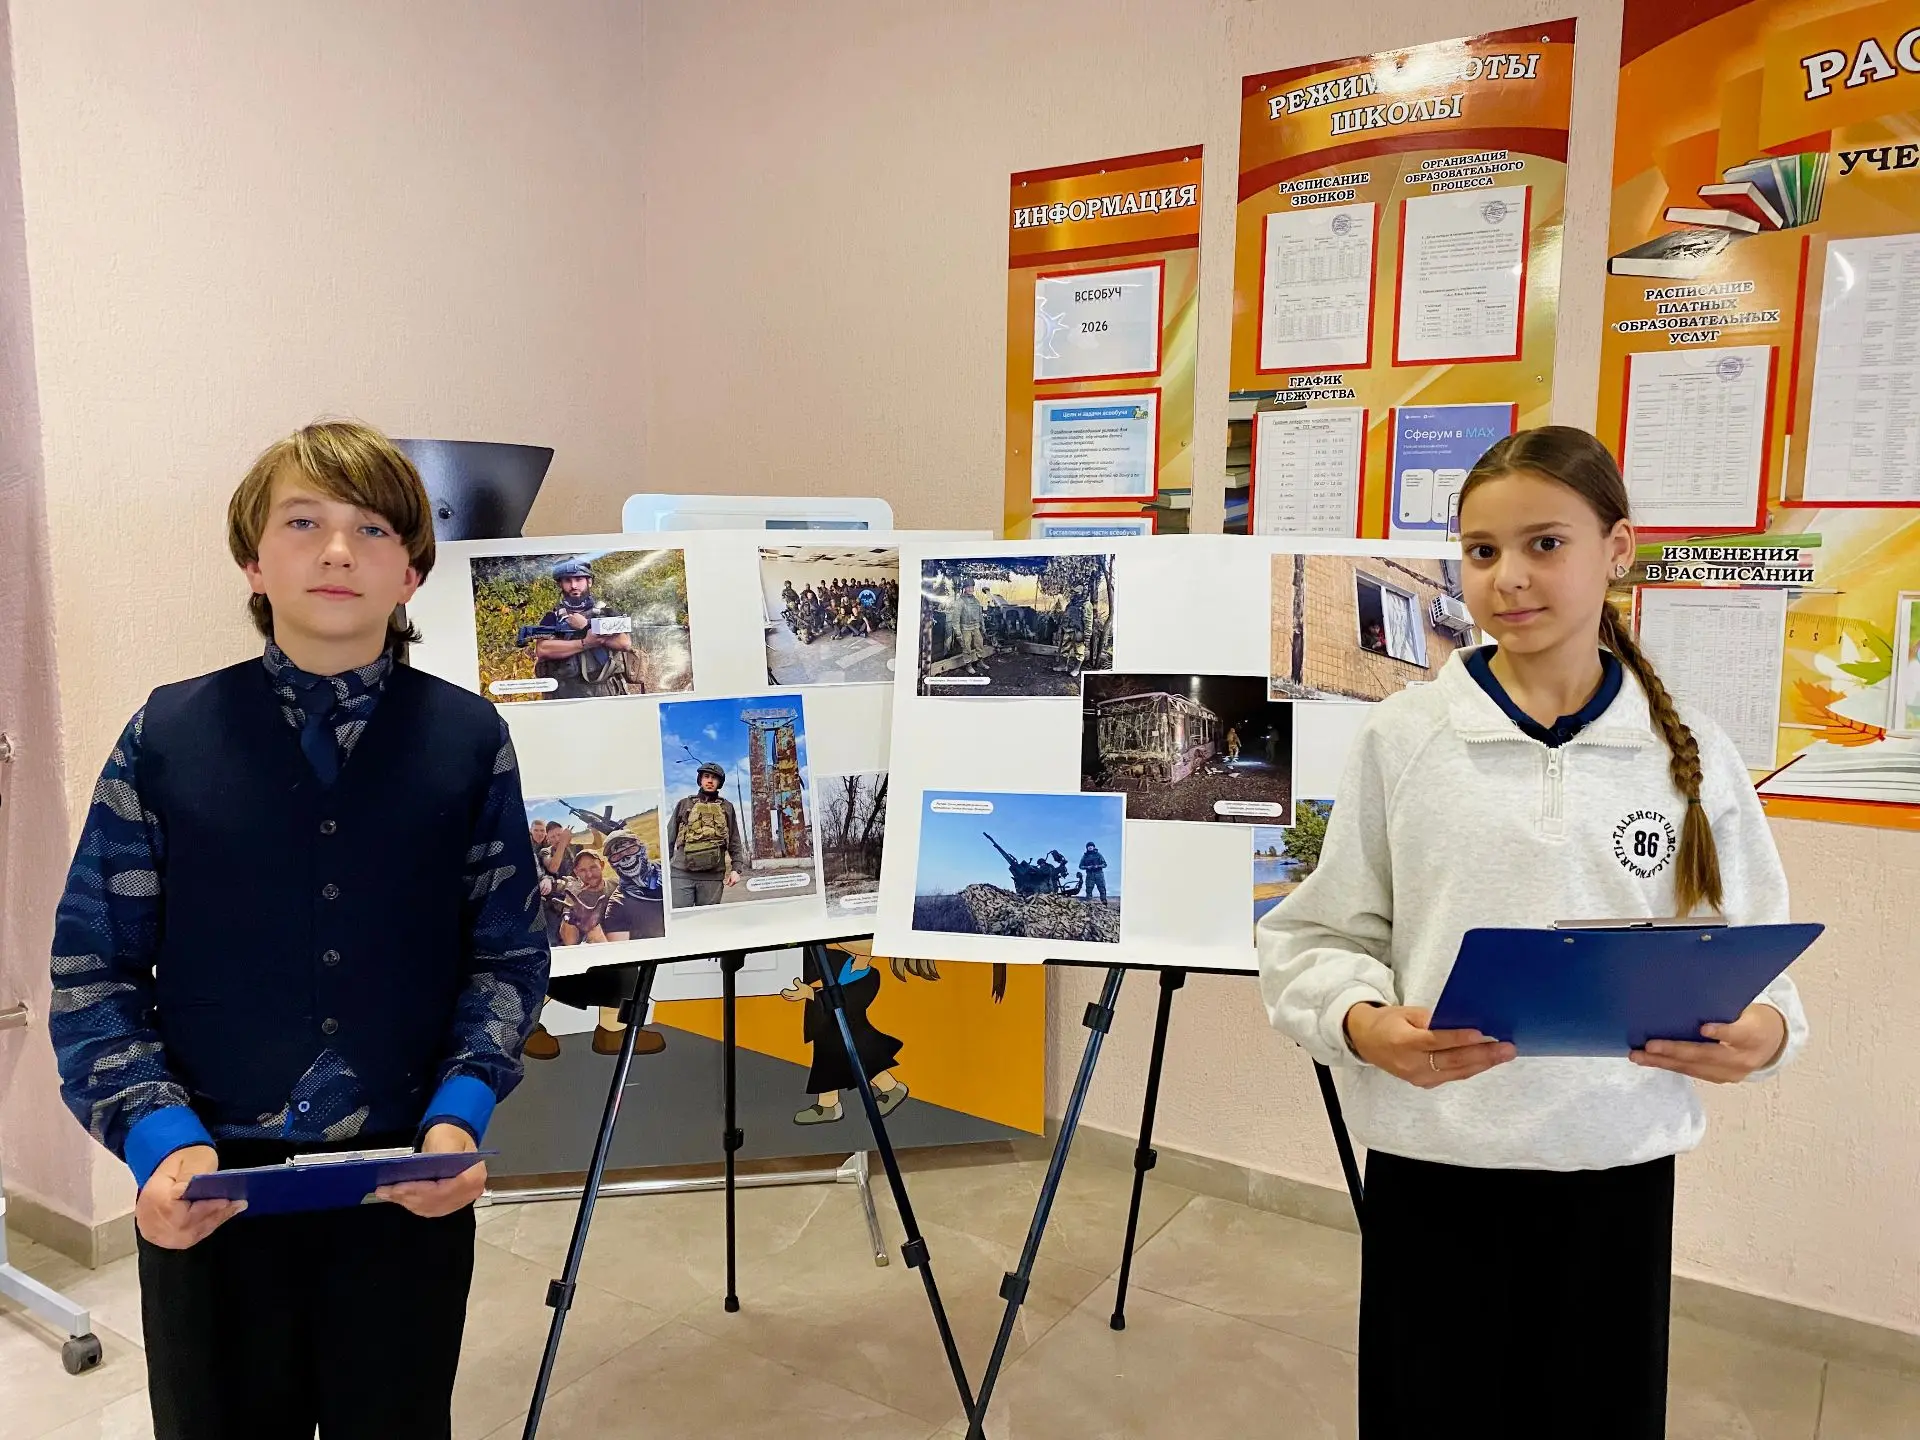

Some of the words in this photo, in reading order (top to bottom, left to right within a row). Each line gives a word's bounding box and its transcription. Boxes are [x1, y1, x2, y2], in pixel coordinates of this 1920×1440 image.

[1331, 94, 1463, 136] ШКОЛЫ
[1422, 151, 1506, 169] ОРГАНИЗАЦИЯ
[1838, 143, 1920, 175] УЧЕ
[1405, 161, 1524, 183] ОБРАЗОВАТЕЛЬНОГО
[1280, 173, 1369, 193] РАСПИСАНИЕ
[1432, 177, 1493, 191] ПРОЦЕССА
[1292, 189, 1355, 205] ЗВОНКОВ
[1013, 184, 1197, 229] ИНФОРМАЦИЯ
[1075, 287, 1122, 302] ВСЕОБУЧ
[1645, 281, 1753, 300] РАСПИСАНИЕ
[1658, 299, 1737, 314] ПЛАТНЫХ
[1081, 320, 1108, 333] 2026
[1619, 311, 1779, 332] ОБРАЗОВАТЕЛЬНЫХ
[1670, 331, 1720, 343] УСЛУГ
[1289, 375, 1342, 387] ГРАФИК
[1275, 389, 1355, 403] ДЕЖУРСТВА
[1404, 428, 1453, 441] Сферум
[1456, 430, 1462, 438] в
[1465, 427, 1495, 438] MAX
[1663, 547, 1800, 561] ИЗМЕНЕНИЯ
[1647, 566, 1660, 579] В
[1667, 567, 1815, 582] РАСПИСАНИИ
[1634, 830, 1660, 858] 86
